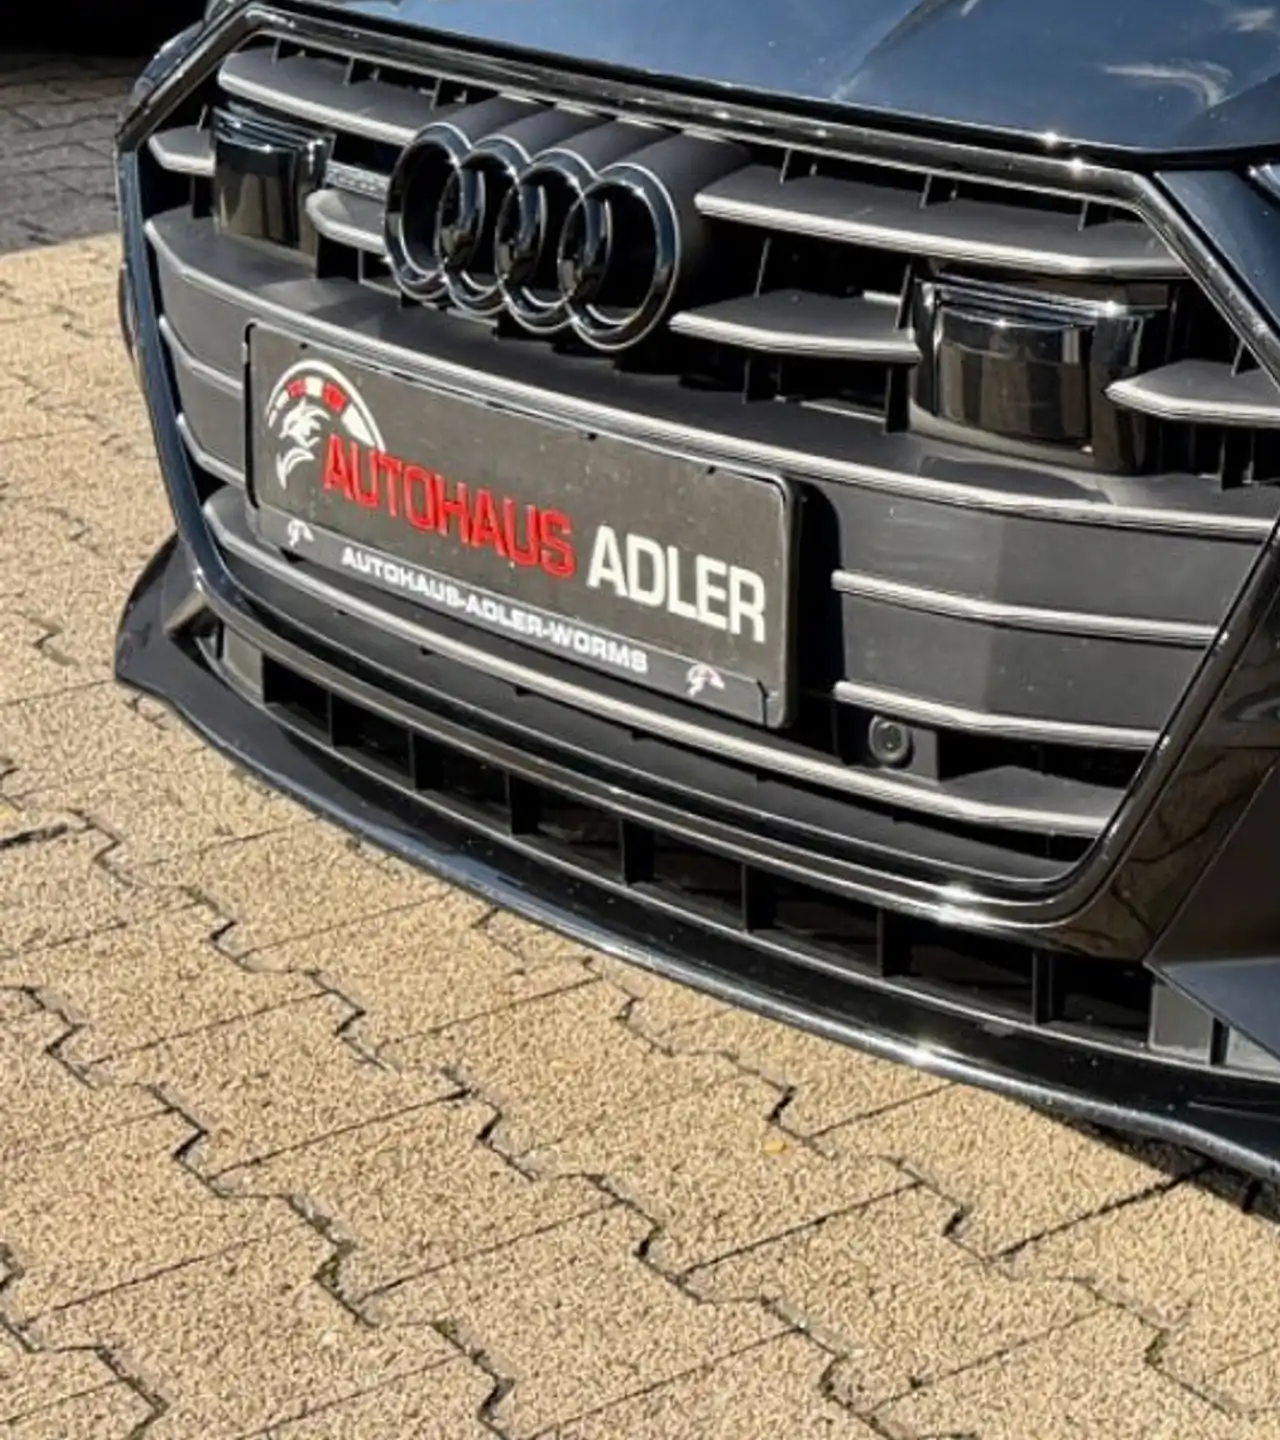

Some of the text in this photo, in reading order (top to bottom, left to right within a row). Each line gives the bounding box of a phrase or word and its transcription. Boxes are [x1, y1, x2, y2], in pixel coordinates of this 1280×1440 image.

[323, 433, 767, 644] AUTOHAUS ADLER
[340, 546, 649, 674] AUTOHAUS-ADLER-WORMS
